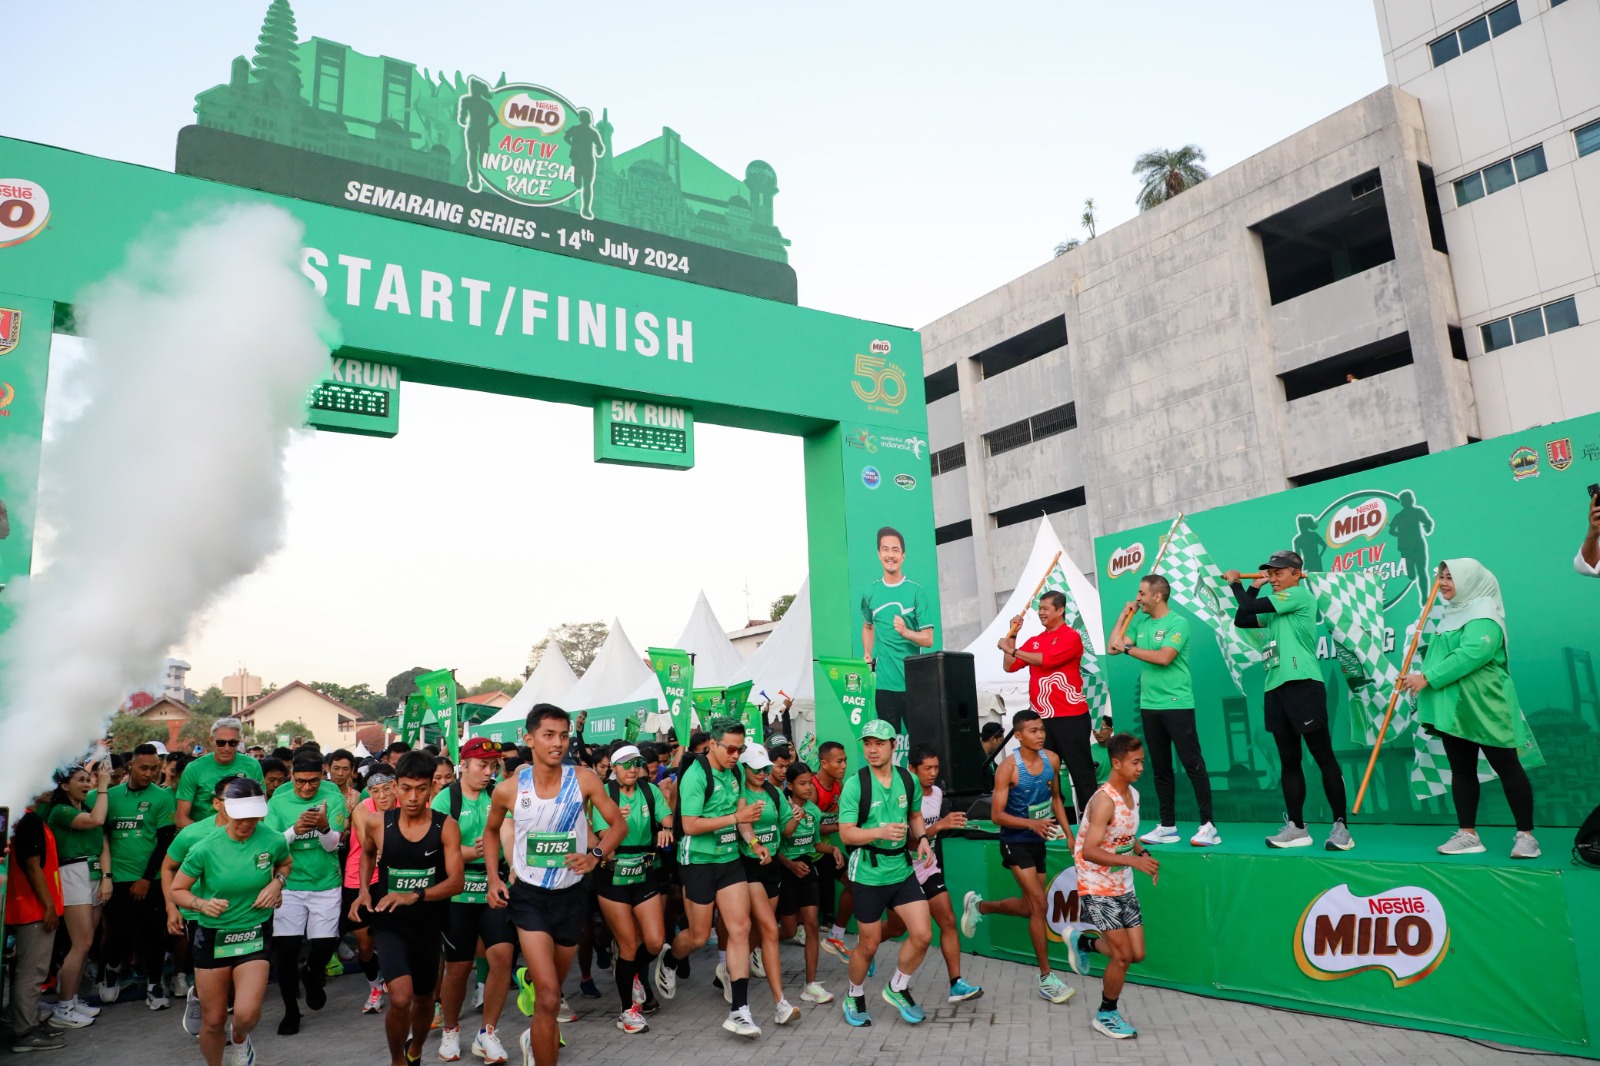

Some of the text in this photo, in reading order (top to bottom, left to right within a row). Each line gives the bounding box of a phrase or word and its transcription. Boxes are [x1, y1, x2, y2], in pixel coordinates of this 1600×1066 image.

[508, 103, 560, 126] MILO
[535, 101, 559, 112] Nestlé
[499, 134, 558, 159] ACTIV
[482, 152, 575, 183] INDONESIA
[506, 175, 552, 196] RACE
[345, 181, 463, 223] SEMARANG
[468, 208, 537, 240] SERIES
[557, 229, 595, 250] 14th
[599, 238, 639, 265] July
[644, 248, 690, 274] 2024
[301, 247, 694, 363] START/FINISH
[872, 343, 889, 351] MILO
[851, 353, 907, 407] 50
[611, 400, 685, 430] 5K RUN
[1356, 502, 1379, 515] Nestlé
[1334, 509, 1382, 539] MILO
[1112, 551, 1142, 572] MILO
[1331, 543, 1385, 572] ACTIV
[666, 686, 684, 697] PACE
[671, 699, 681, 716] 6
[842, 695, 866, 706] PACE
[438, 707, 452, 719] PACE
[850, 708, 862, 725] 6
[407, 721, 420, 729] PACE
[444, 720, 451, 738] 7
[590, 719, 615, 733] TIMING
[408, 730, 415, 744] 7
[536, 842, 570, 853] 51752
[396, 878, 429, 889] 51246
[1368, 897, 1425, 914] Nestlé
[224, 931, 257, 943] 50699
[1314, 914, 1434, 957] MILO
